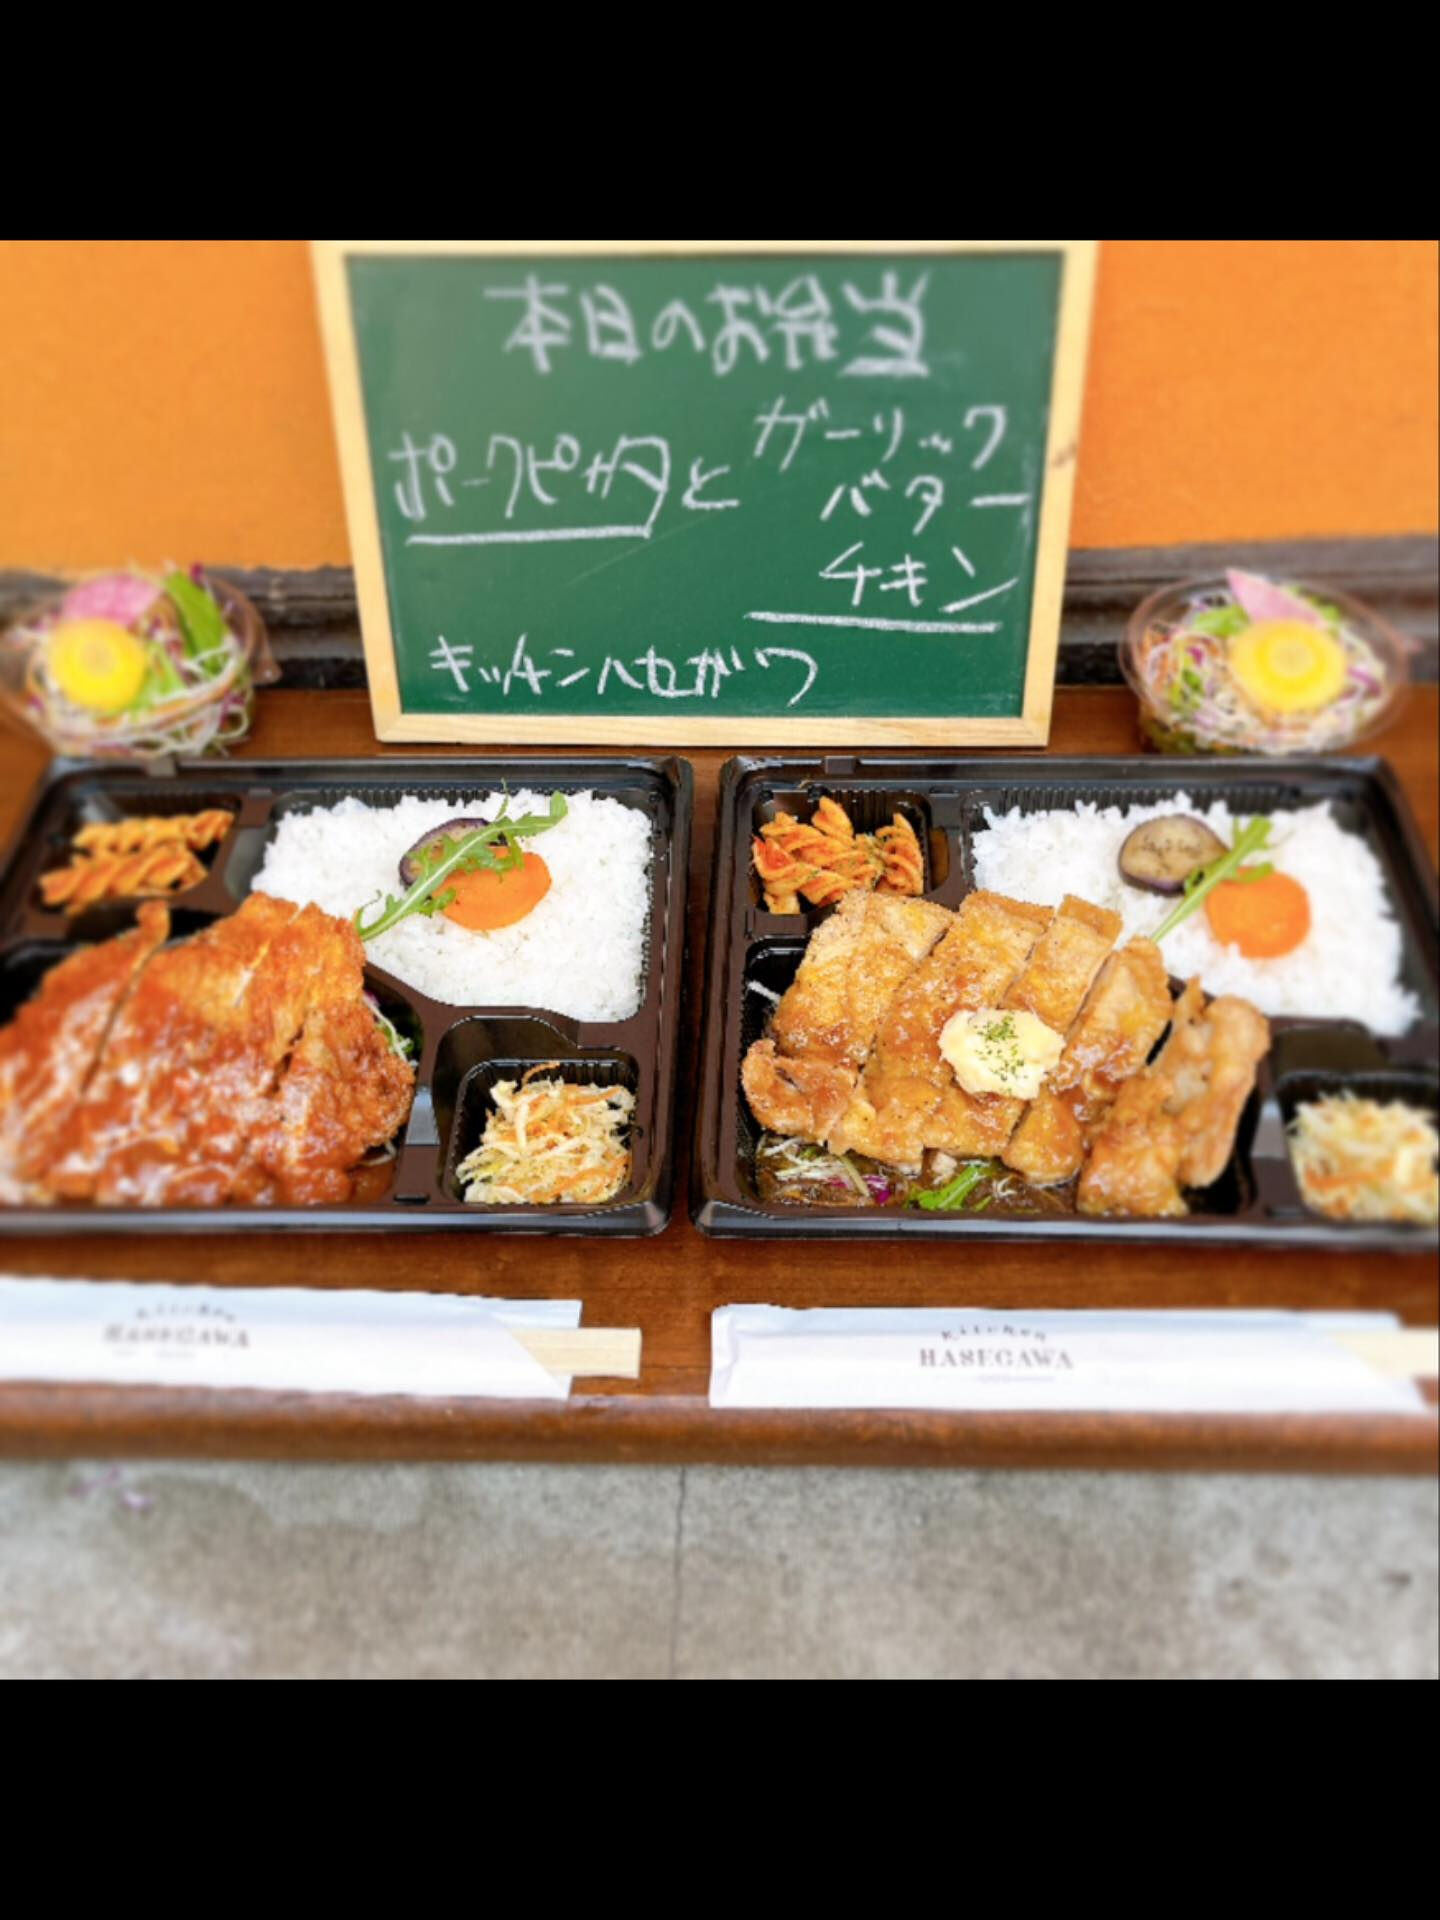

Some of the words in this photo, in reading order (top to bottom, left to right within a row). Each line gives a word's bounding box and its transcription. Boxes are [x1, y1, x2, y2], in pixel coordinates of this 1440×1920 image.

[484, 272, 930, 377] 本日のお弁当
[754, 396, 1007, 473] ガーリック
[820, 471, 1030, 534] バター
[818, 542, 1018, 613] チキン
[919, 1348, 1073, 1369] HASEGAWA
